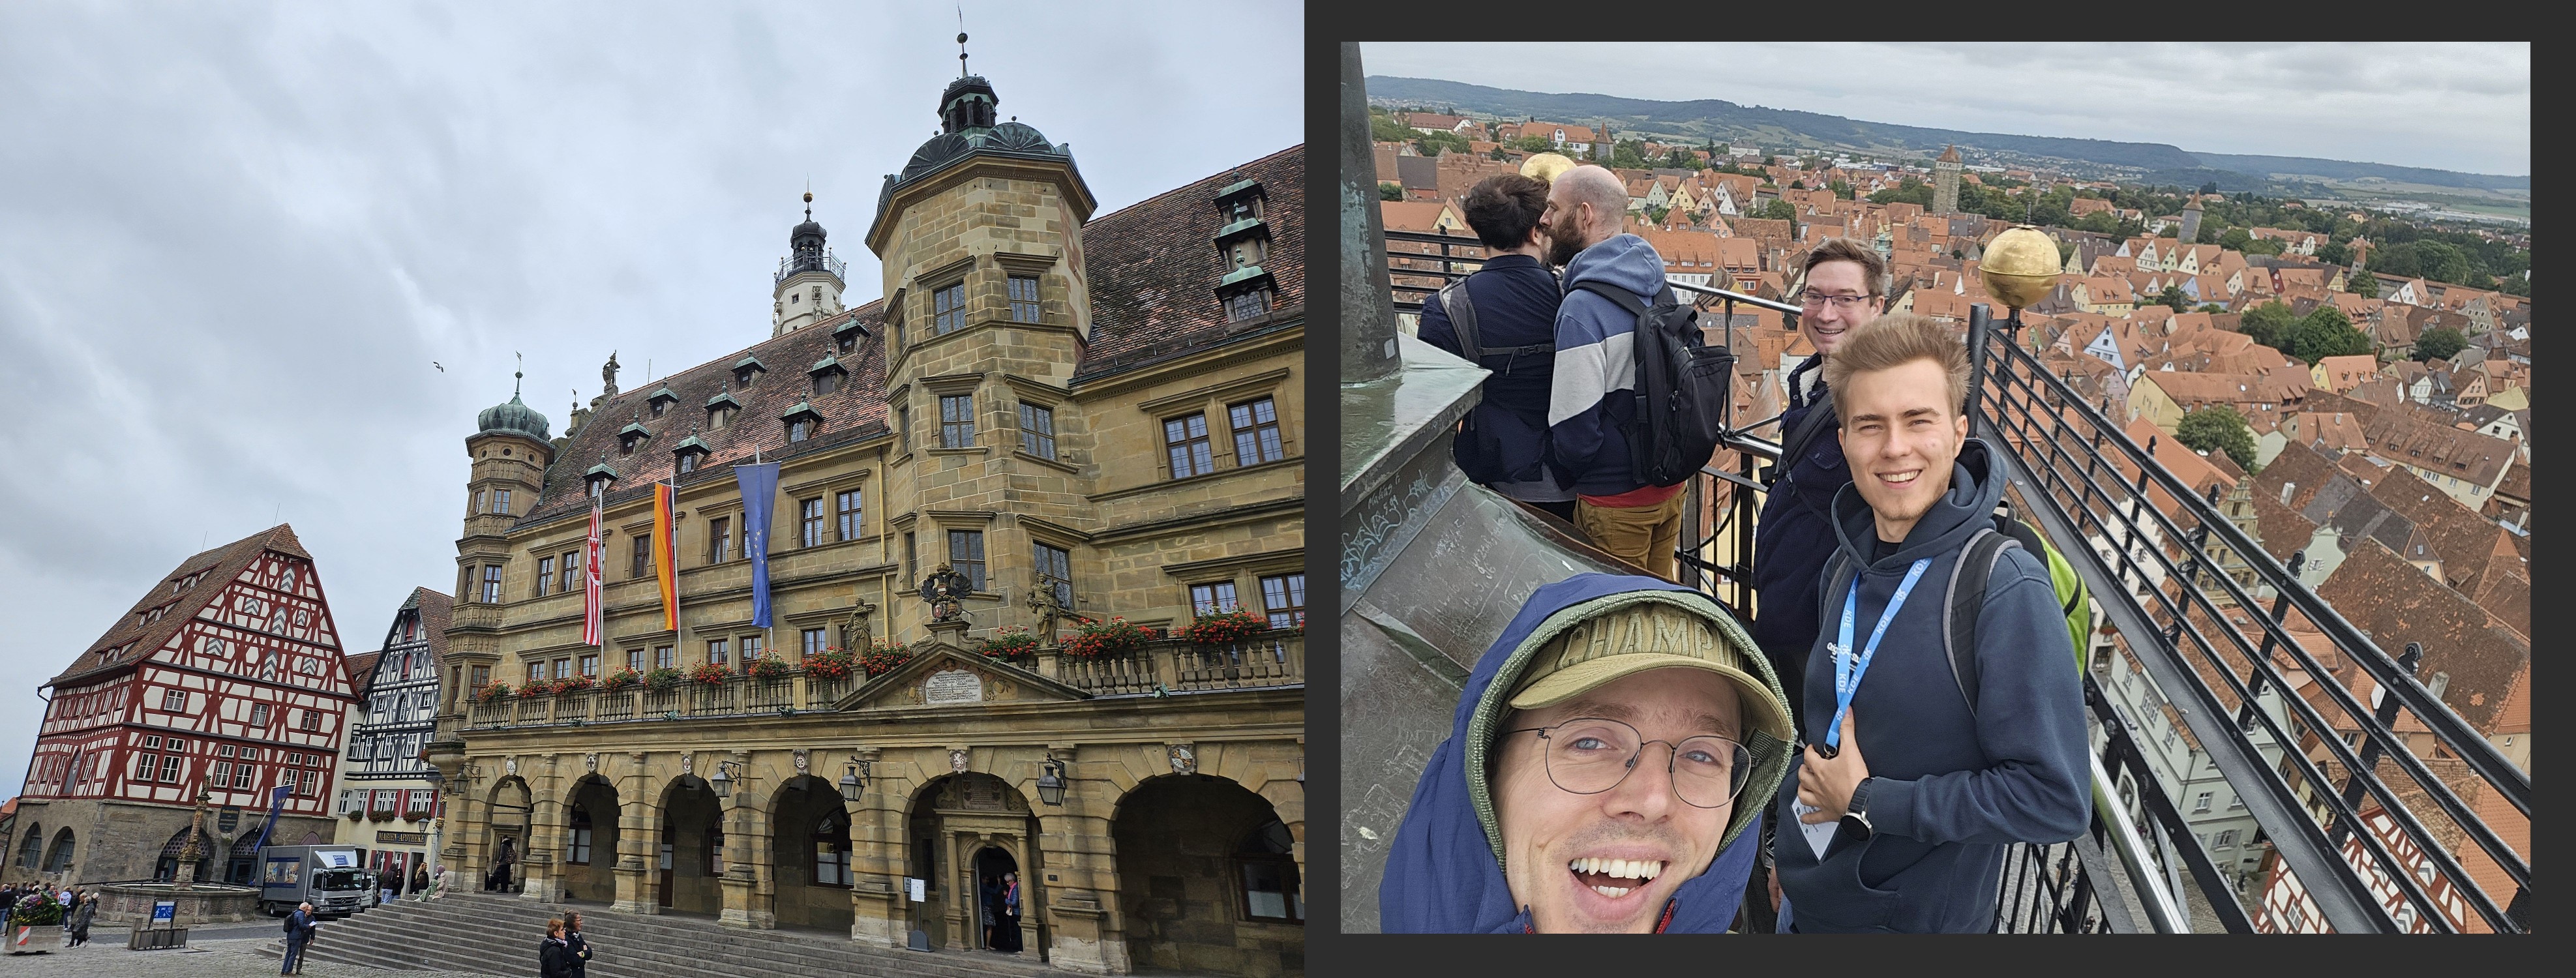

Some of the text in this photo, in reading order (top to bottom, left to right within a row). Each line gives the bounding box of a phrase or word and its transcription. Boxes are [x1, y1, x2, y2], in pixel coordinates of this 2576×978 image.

[1911, 559, 1928, 576] KDE
[1844, 610, 1852, 629] KDE
[1876, 614, 1891, 634] KDE
[1555, 612, 1744, 672] CHAMPI
[1847, 674, 1859, 694] KDE
